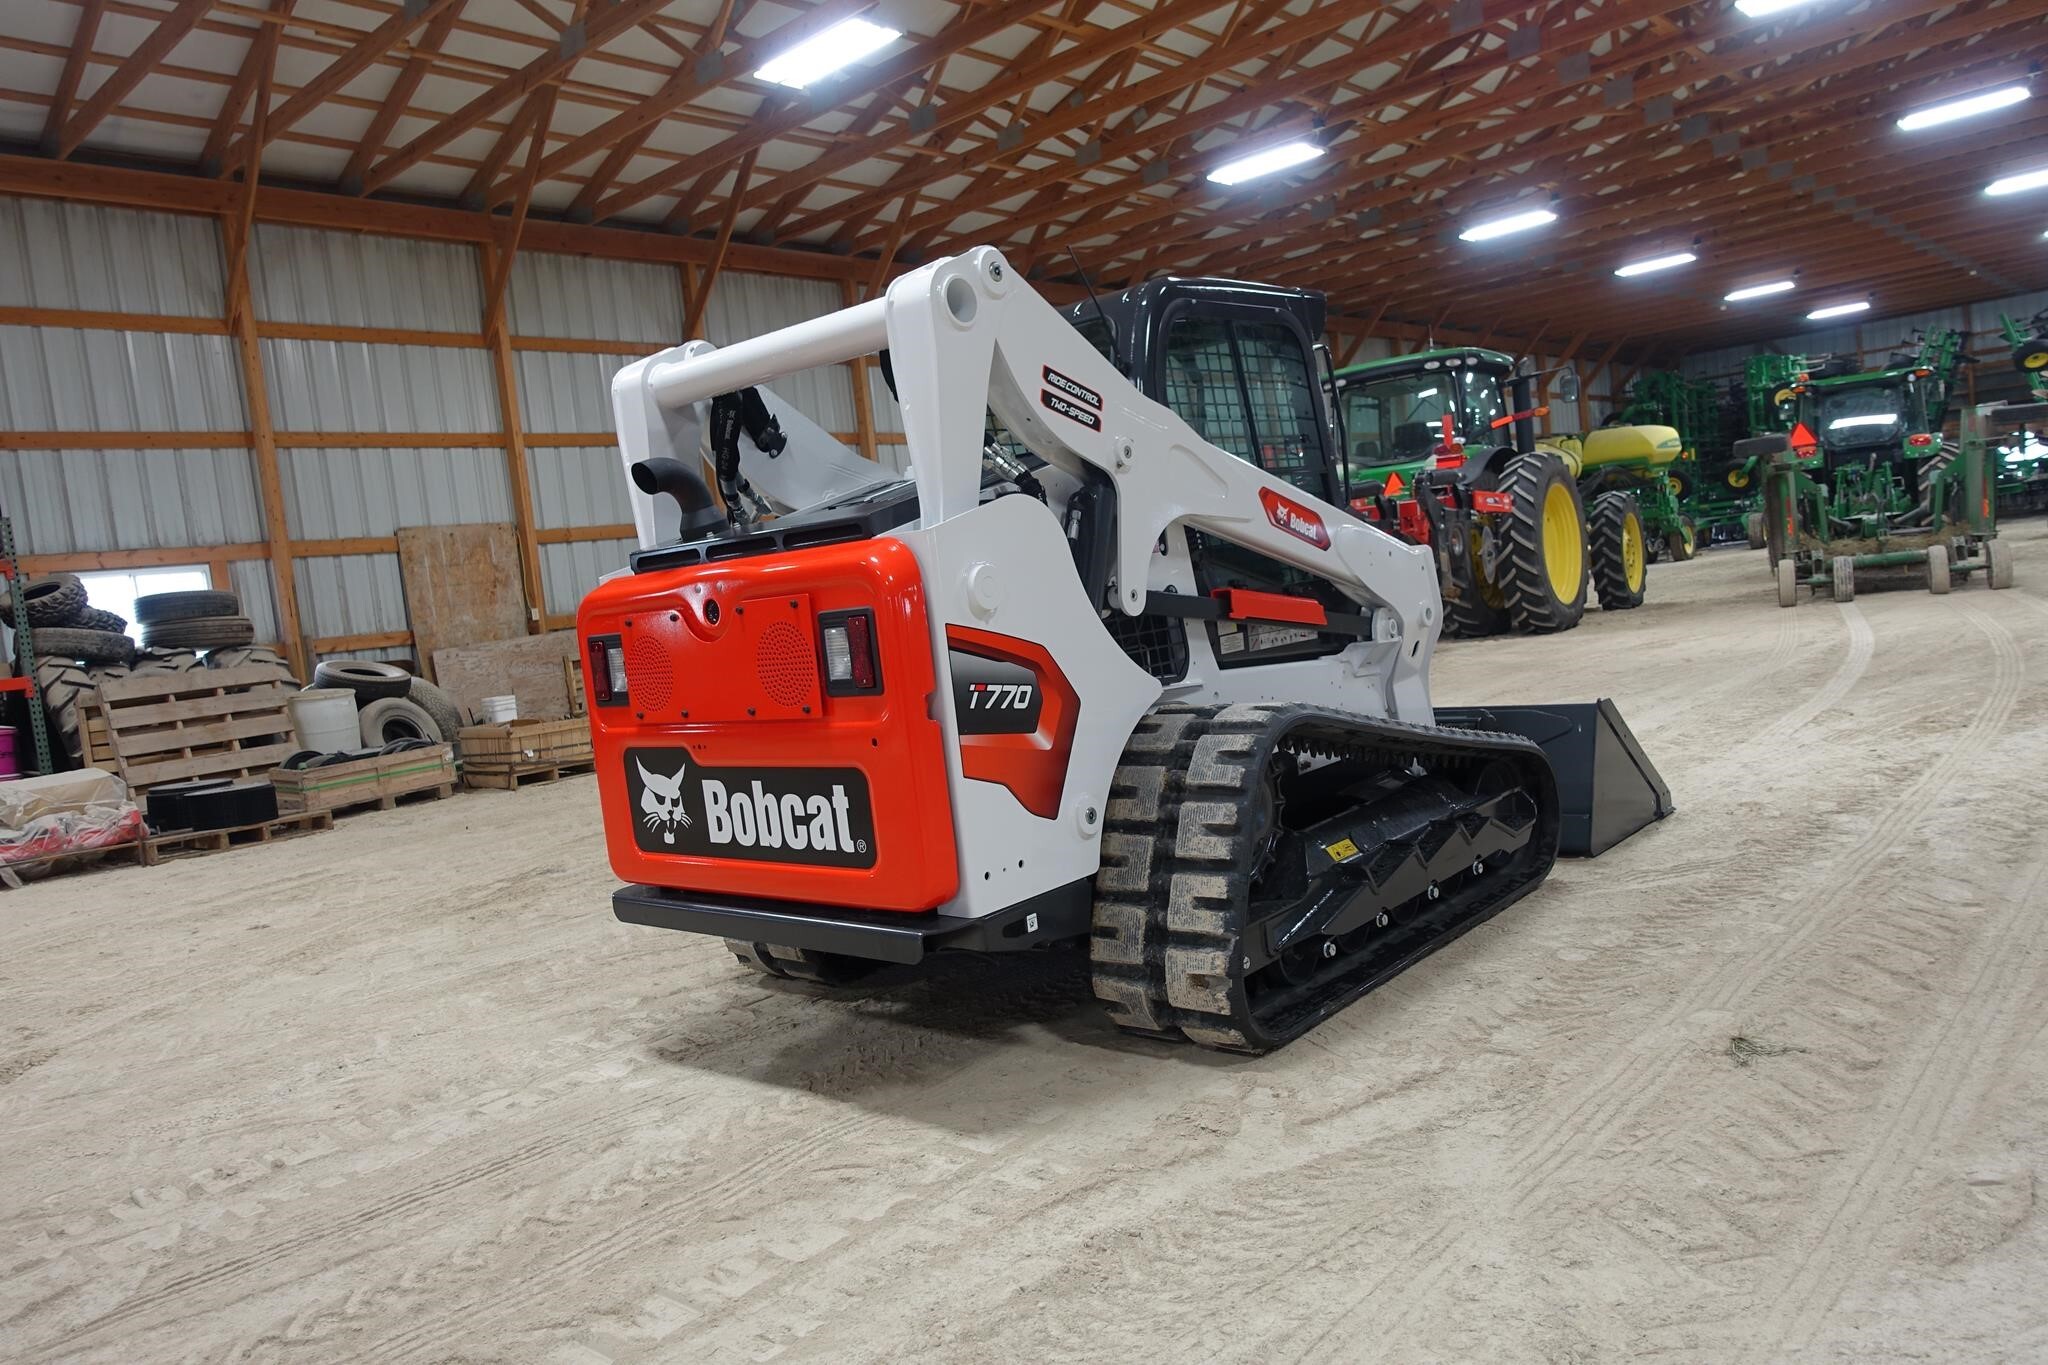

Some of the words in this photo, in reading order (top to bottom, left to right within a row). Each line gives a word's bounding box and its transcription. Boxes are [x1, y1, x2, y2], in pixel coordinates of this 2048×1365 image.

[1047, 373, 1068, 388] RIDE
[1065, 382, 1099, 406] CONTROL
[1051, 398, 1095, 424] TWO-SPEED
[1290, 513, 1317, 539] Bobcat
[702, 779, 855, 853] Bobcat
